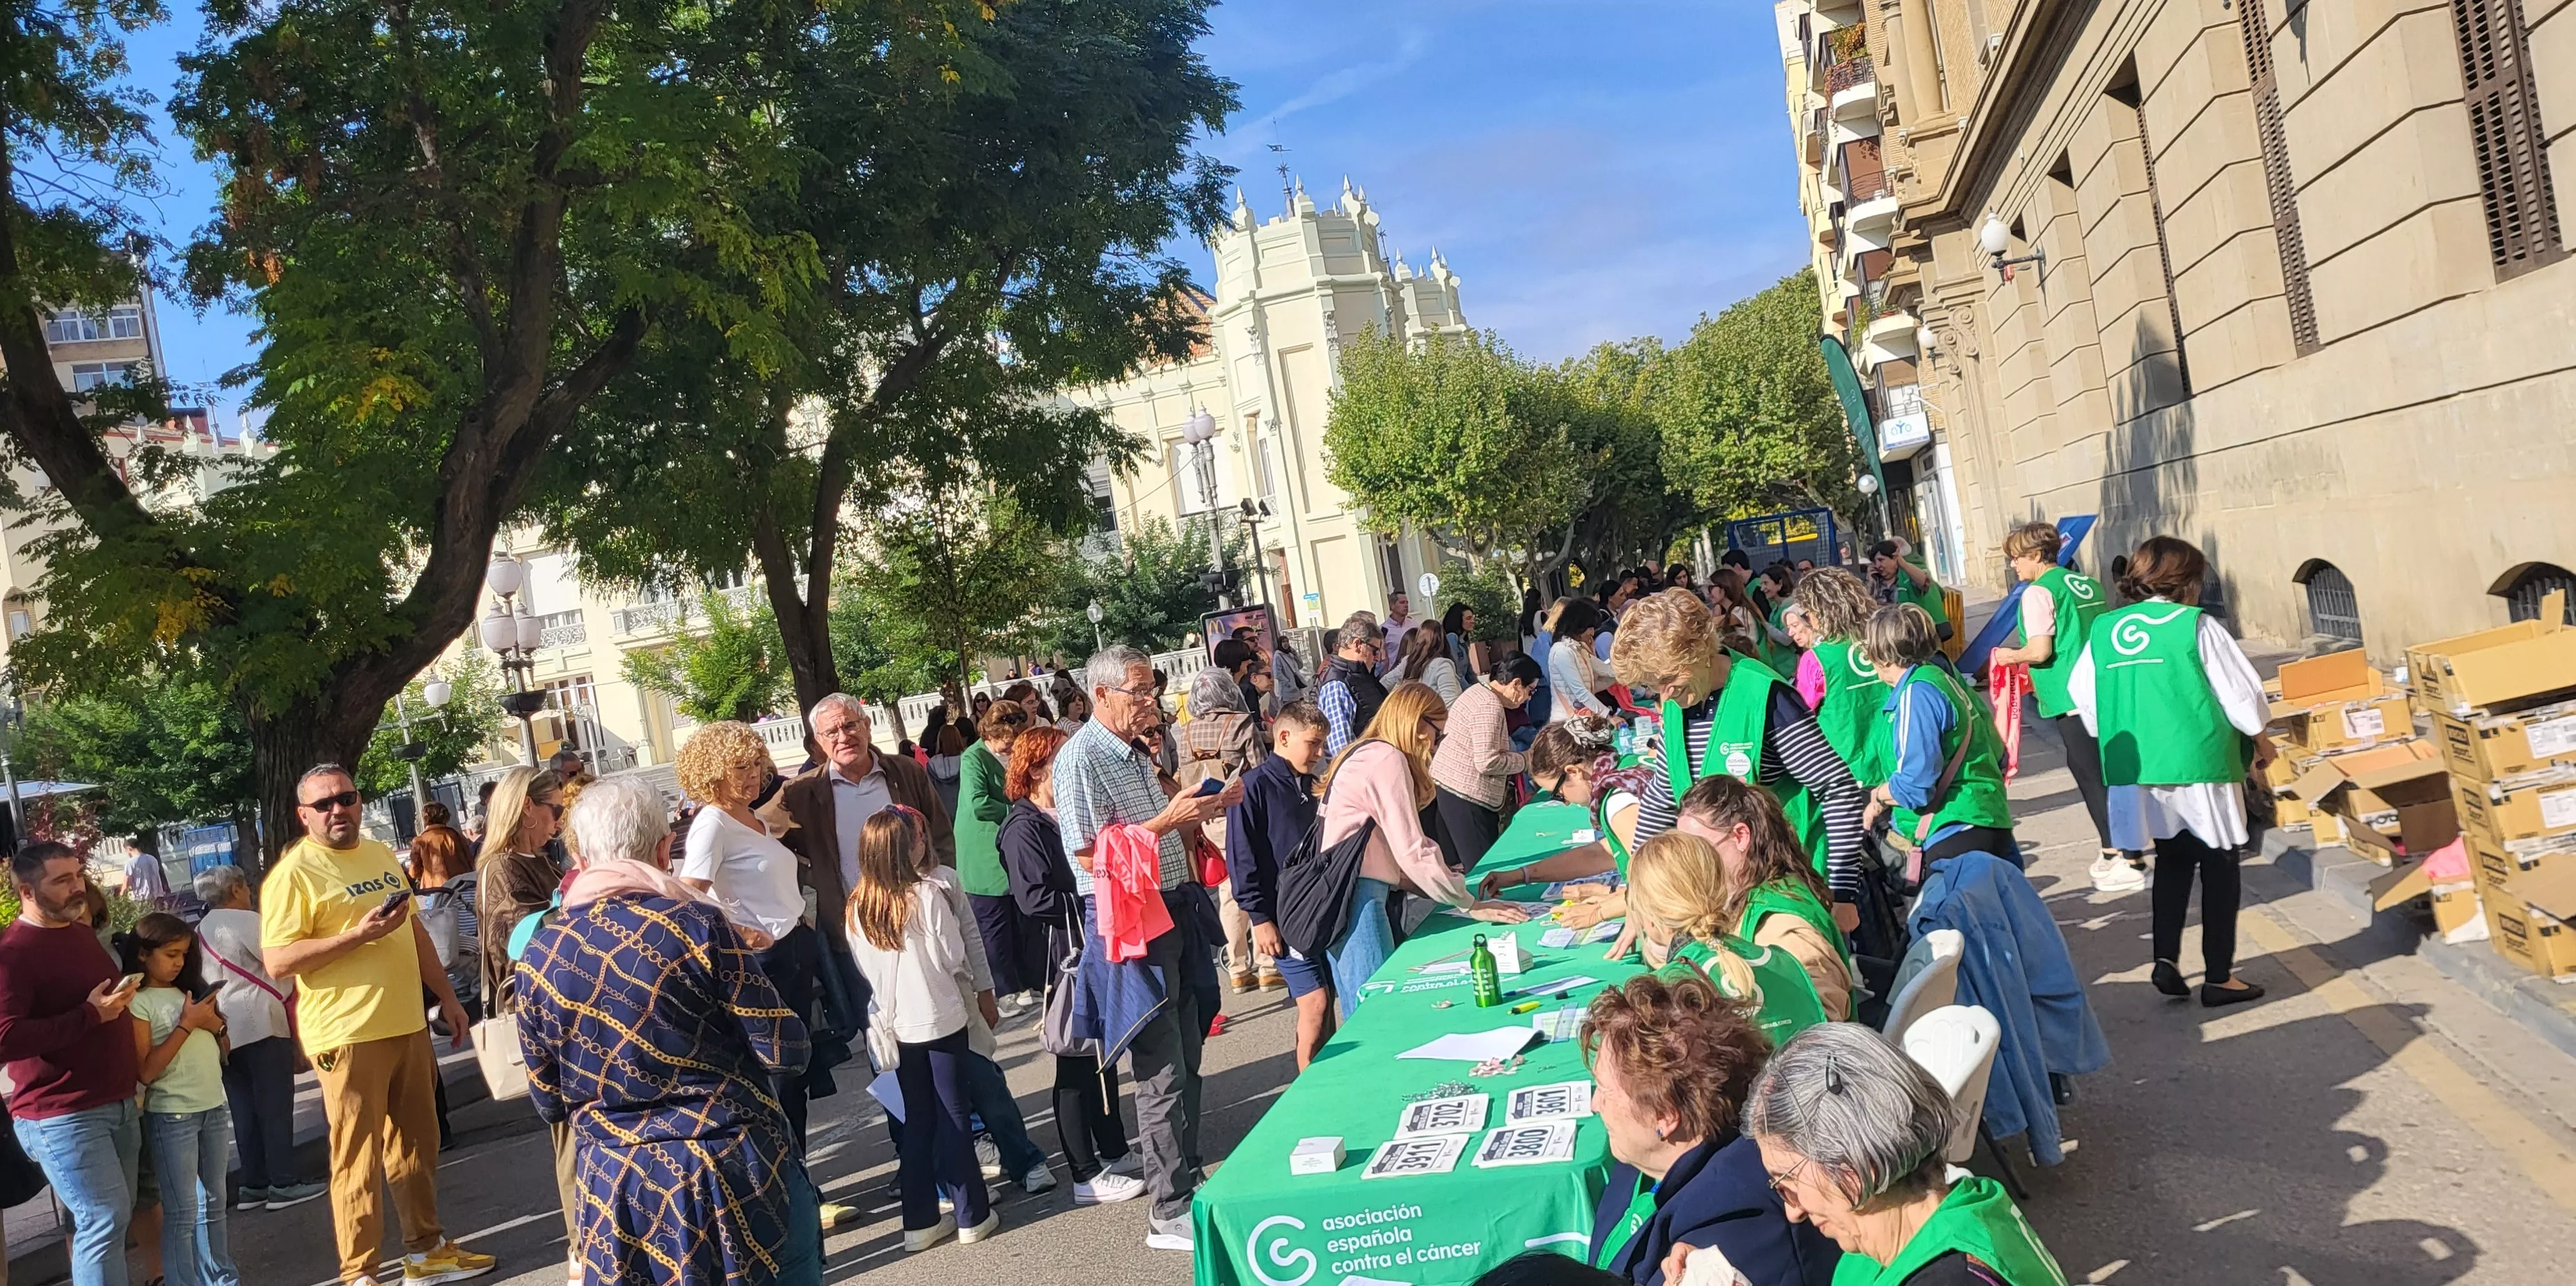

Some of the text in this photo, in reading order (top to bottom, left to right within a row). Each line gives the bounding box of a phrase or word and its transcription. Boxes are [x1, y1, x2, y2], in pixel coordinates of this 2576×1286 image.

[1430, 1102, 1463, 1127] 3702
[1536, 1090, 1566, 1115] 3601
[1396, 1143, 1441, 1170] 3911
[1508, 1129, 1549, 1157] 3800
[1323, 1204, 1422, 1230] asociación
[1327, 1226, 1413, 1253] española
[1332, 1241, 1482, 1275] contra el cáncer
